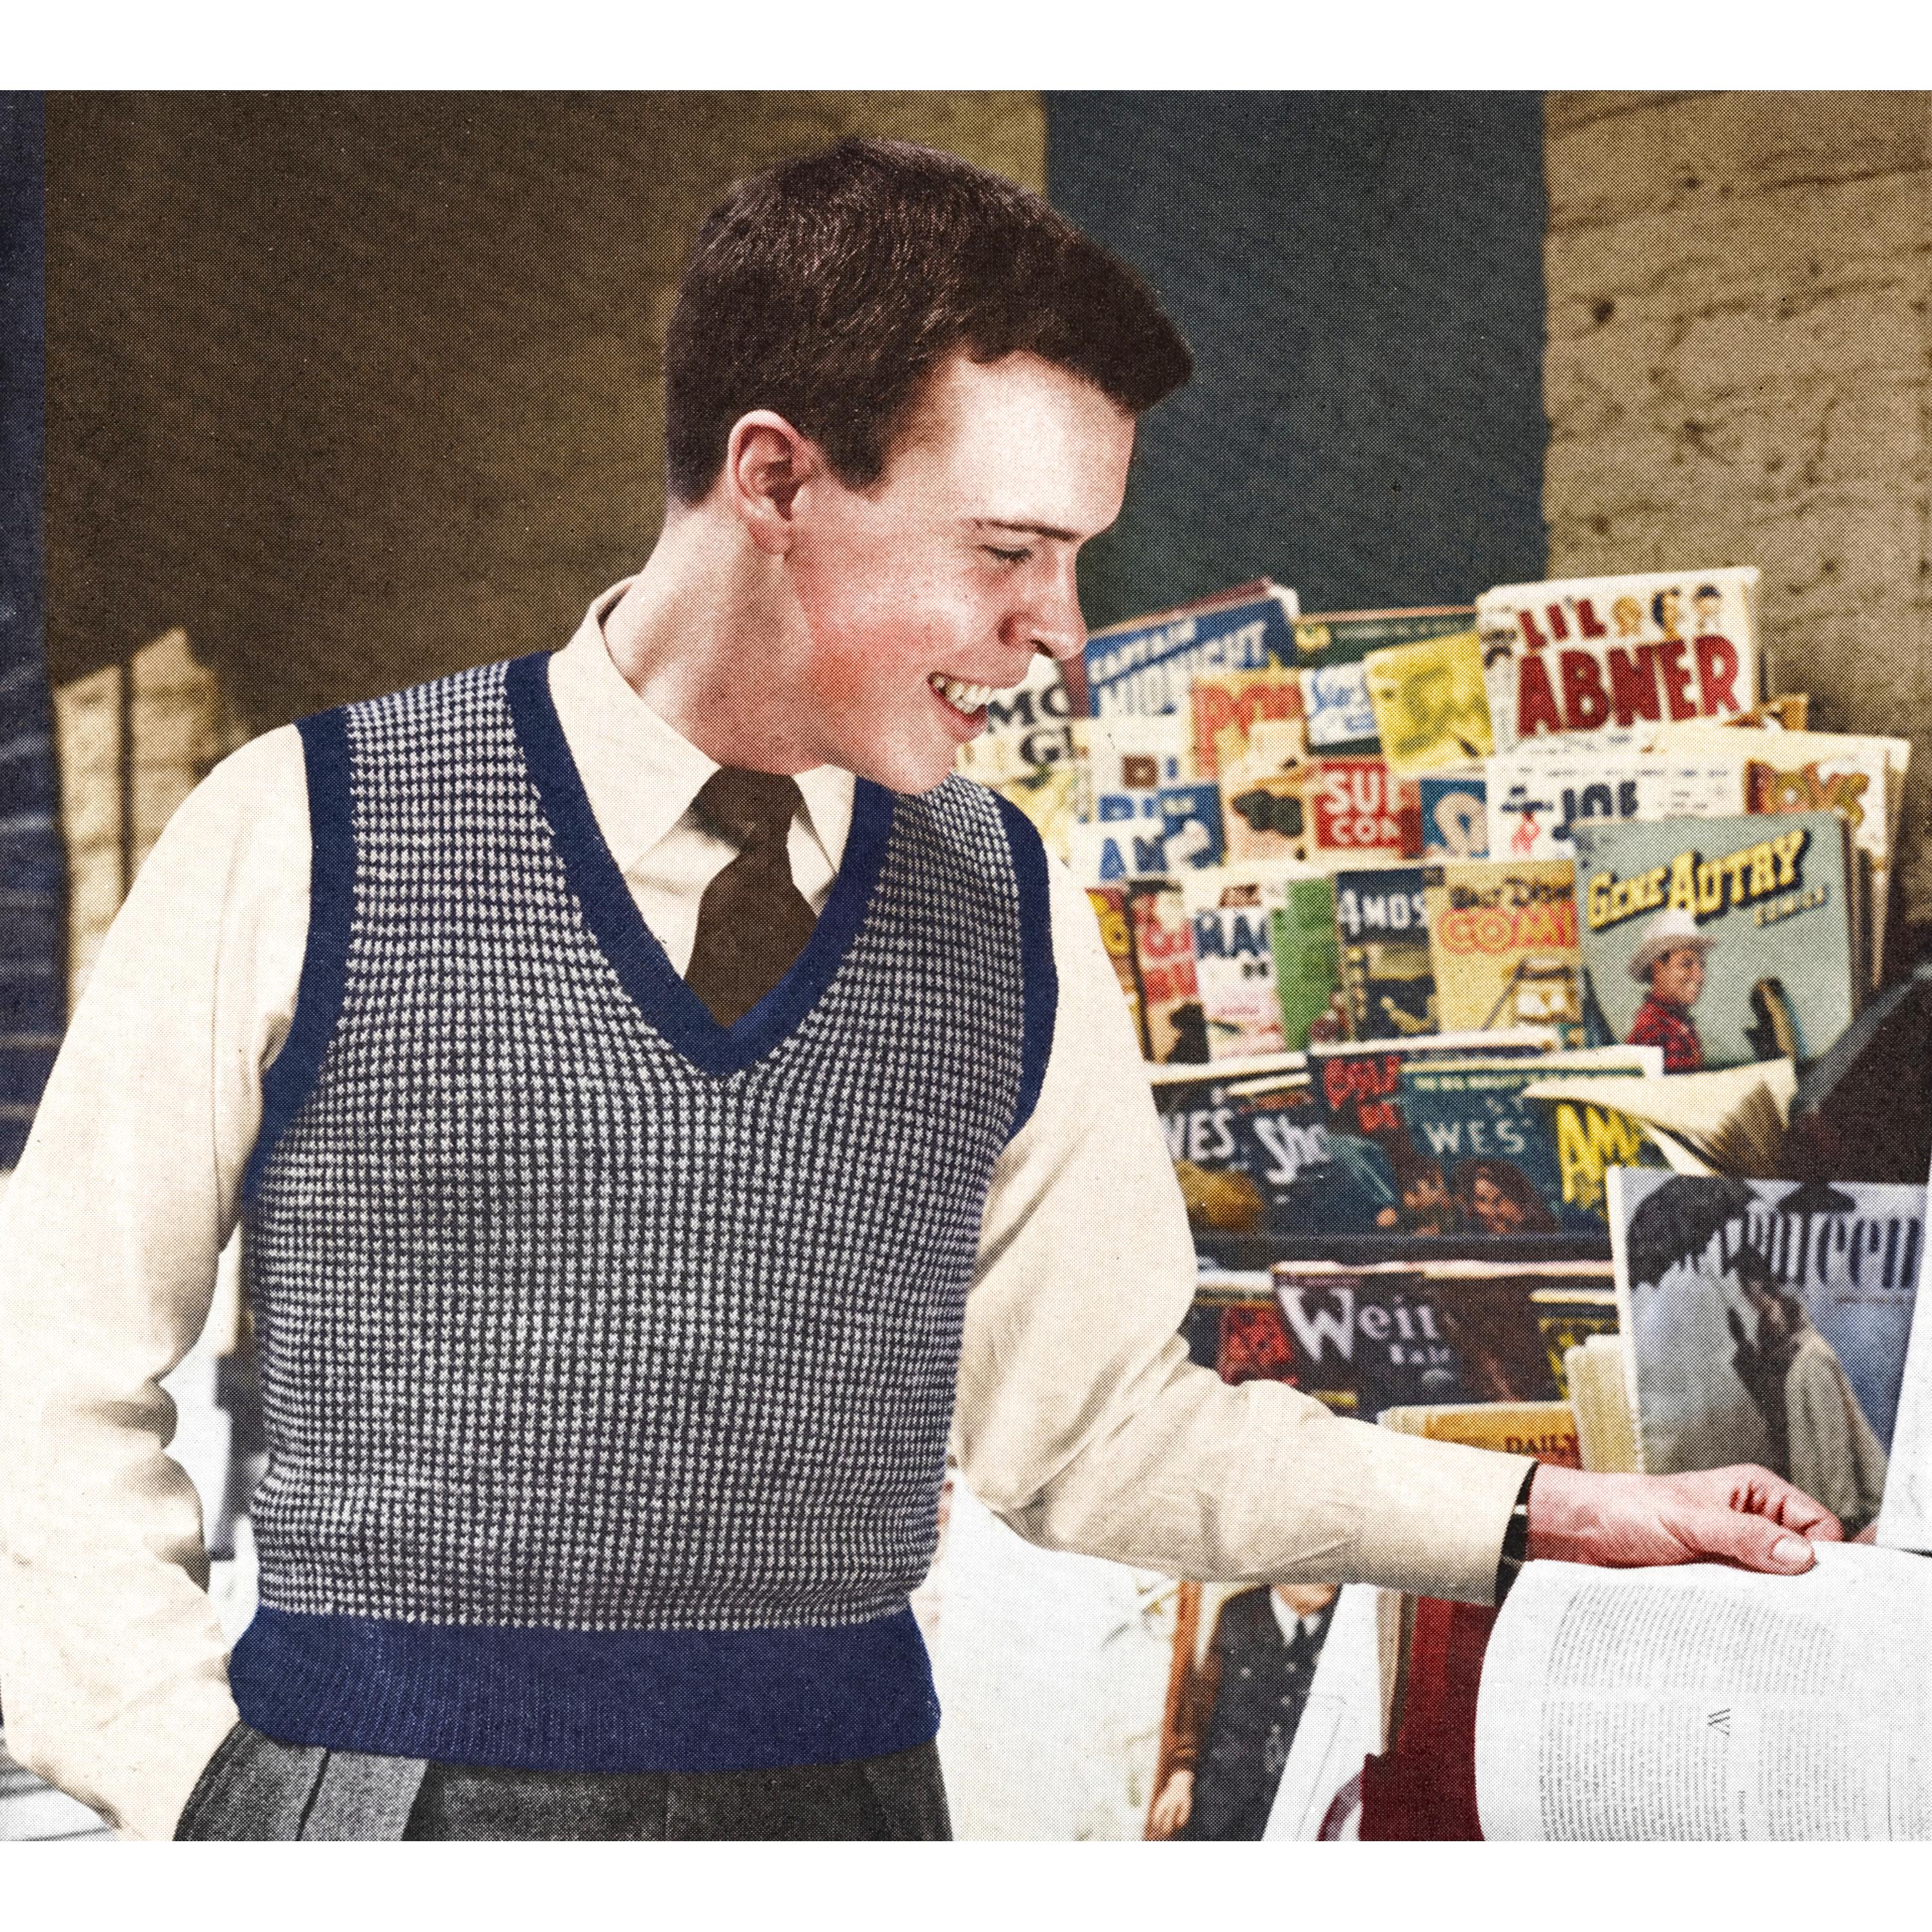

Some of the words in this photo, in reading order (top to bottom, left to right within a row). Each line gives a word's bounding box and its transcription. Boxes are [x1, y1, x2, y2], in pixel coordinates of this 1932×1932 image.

[1517, 596, 1606, 647] LI'L
[1515, 634, 1741, 738] ABNER
[1587, 866, 1669, 933] GENE
[1666, 829, 1810, 925] AUTRY
